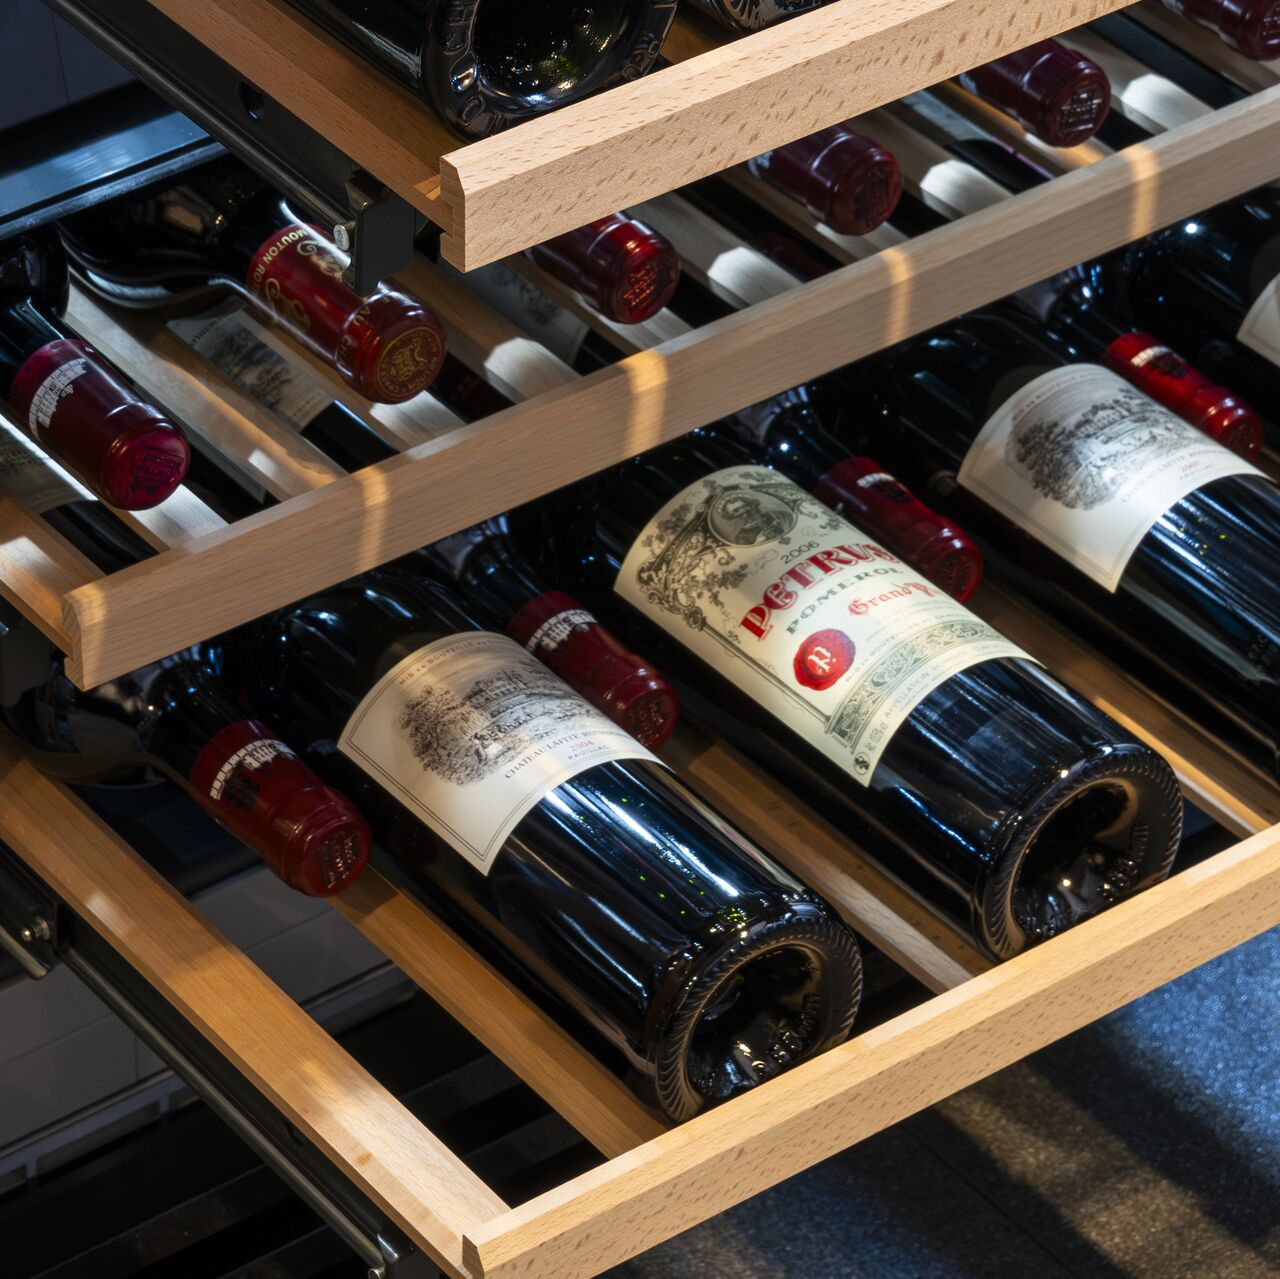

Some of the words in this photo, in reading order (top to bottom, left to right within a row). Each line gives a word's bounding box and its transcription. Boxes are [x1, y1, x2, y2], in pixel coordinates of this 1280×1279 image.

[262, 227, 308, 265] MOUTON
[780, 540, 820, 565] 2006
[786, 567, 905, 635] POMEROL
[847, 582, 913, 616] Grand
[398, 672, 415, 687] MIS
[504, 745, 547, 780] CHATEAU
[547, 733, 578, 751] LAFITE
